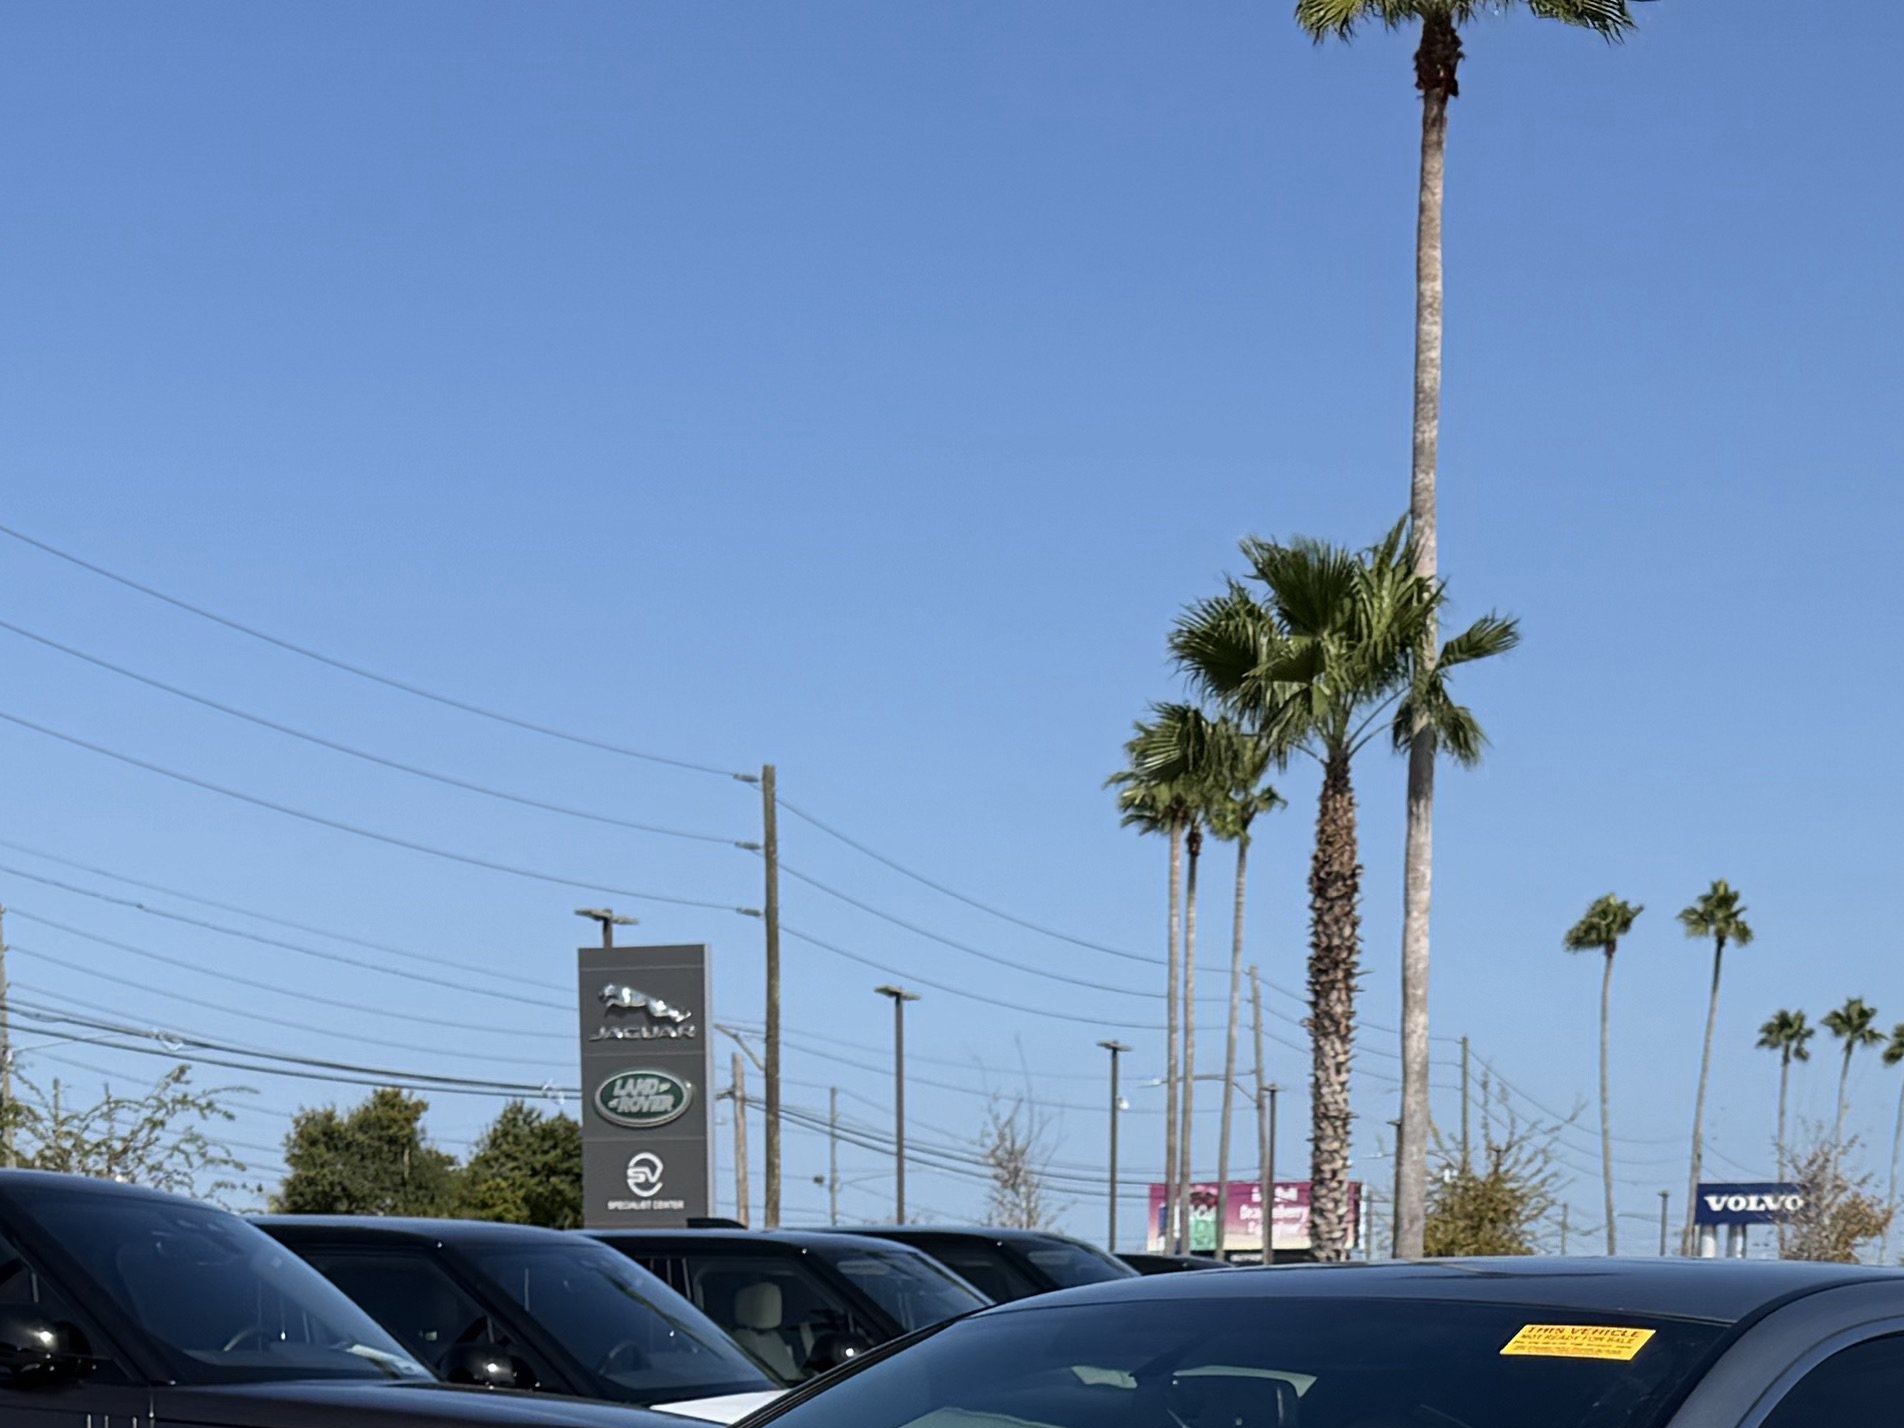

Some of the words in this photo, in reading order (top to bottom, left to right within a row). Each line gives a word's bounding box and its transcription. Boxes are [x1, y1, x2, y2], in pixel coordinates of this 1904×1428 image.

[590, 1025, 696, 1041] JAGUAR
[613, 1077, 660, 1097] LAND
[617, 1094, 676, 1113] ROVER
[653, 1199, 685, 1211] CENTER
[1704, 1194, 1805, 1212] VOLVO
[1571, 1327, 1640, 1338] VEHICLE
